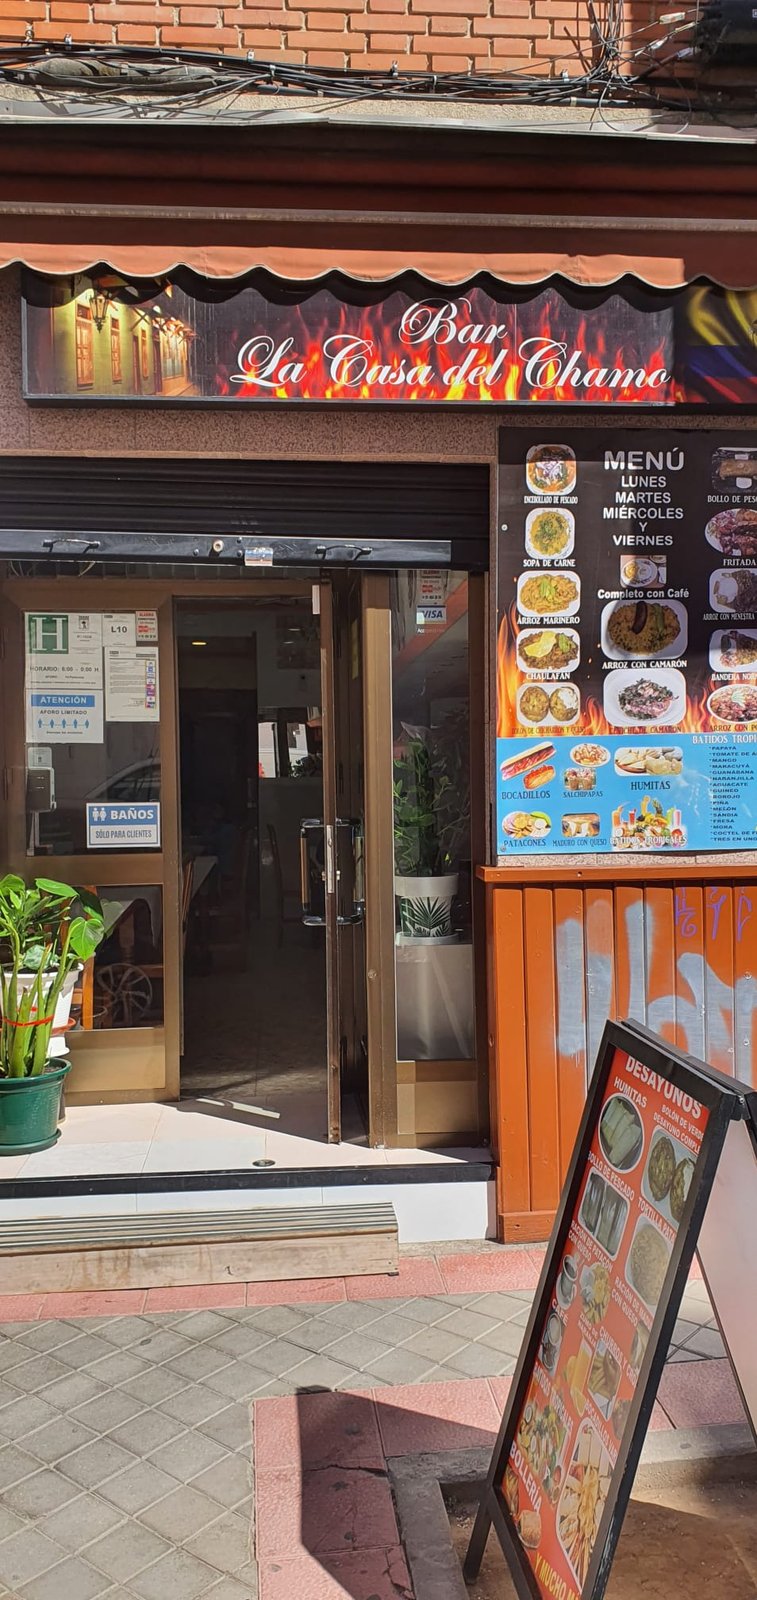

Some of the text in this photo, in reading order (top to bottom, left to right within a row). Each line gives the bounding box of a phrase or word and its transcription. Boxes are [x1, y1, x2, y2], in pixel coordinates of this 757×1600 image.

[399, 298, 507, 344] Bar
[230, 334, 671, 389] La Casa del Chamo
[604, 447, 685, 471] MENÚ
[621, 476, 667, 488] LUNES
[553, 496, 559, 504] DE
[615, 492, 671, 504] MARTES
[708, 495, 729, 503] BOLLO
[731, 495, 741, 503] DE
[603, 505, 683, 519] MIÉRCOLES
[639, 522, 647, 532] Y
[613, 535, 673, 546] VIERNES
[523, 559, 576, 567] SOPA DE CARNE
[597, 589, 643, 600] Completo
[667, 588, 689, 598] Café
[420, 610, 443, 619] VISA
[517, 616, 580, 625] ARROZ MARINERO
[32, 617, 67, 650] H
[602, 658, 688, 669] ARROZ CON CAMARÓN
[40, 695, 87, 704] ATENCIÓN
[692, 735, 728, 744] BATIDOS
[631, 781, 671, 791] HUMITAS
[501, 791, 550, 800] BOCADILLOS
[110, 808, 154, 820] BAÑOS
[111, 830, 126, 838] PARA
[127, 829, 152, 838] CLIENTES
[503, 839, 547, 847] PATACONES
[552, 839, 575, 847] MADURO
[589, 839, 607, 847] QUESO
[614, 1077, 647, 1107] HUMITAS
[625, 1056, 702, 1119] DESAYUNOS
[653, 1112, 680, 1137] DESAYUNO
[680, 1118, 687, 1128] DE
[603, 1166, 610, 1177] DE
[610, 1172, 634, 1200] PESCADO
[637, 1198, 662, 1229] TORTILLA
[611, 1289, 638, 1326] CON QUESO
[599, 1326, 623, 1362] CHURROS
[510, 1440, 542, 1513] BOLLERÍA
[535, 1552, 566, 1600] Y MUCHO
